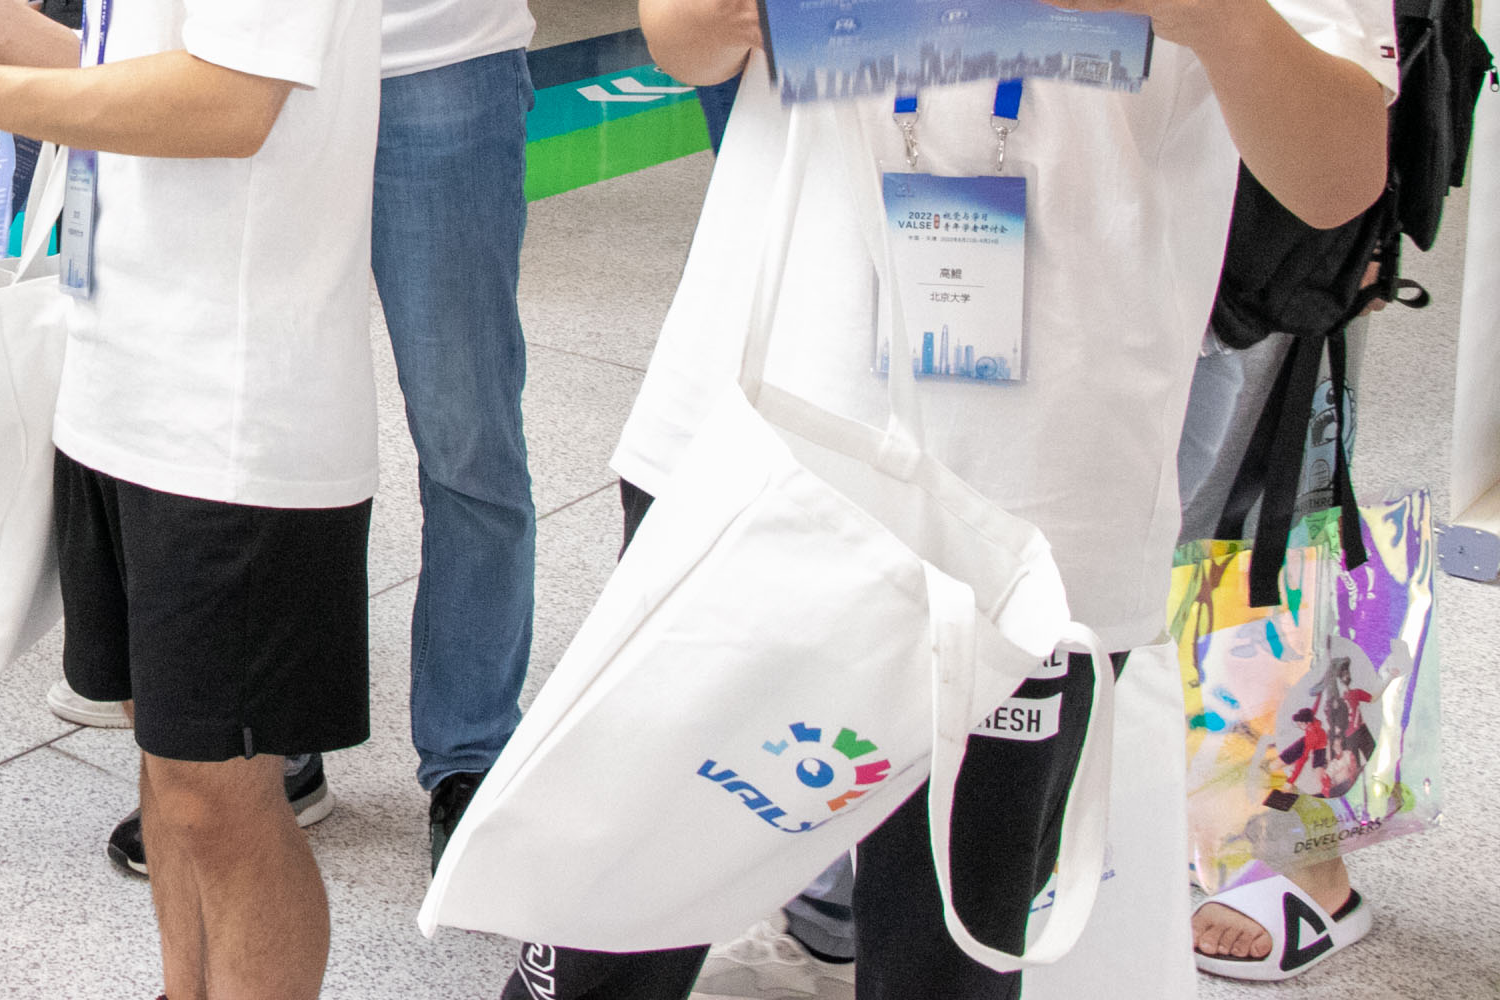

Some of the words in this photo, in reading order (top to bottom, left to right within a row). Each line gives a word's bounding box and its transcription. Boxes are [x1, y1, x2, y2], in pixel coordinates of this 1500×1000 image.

[908, 212, 932, 220] 2022
[898, 221, 932, 229] VALSE
[930, 292, 971, 304] 北京大学
[1294, 817, 1382, 853] DEVELOPERS
